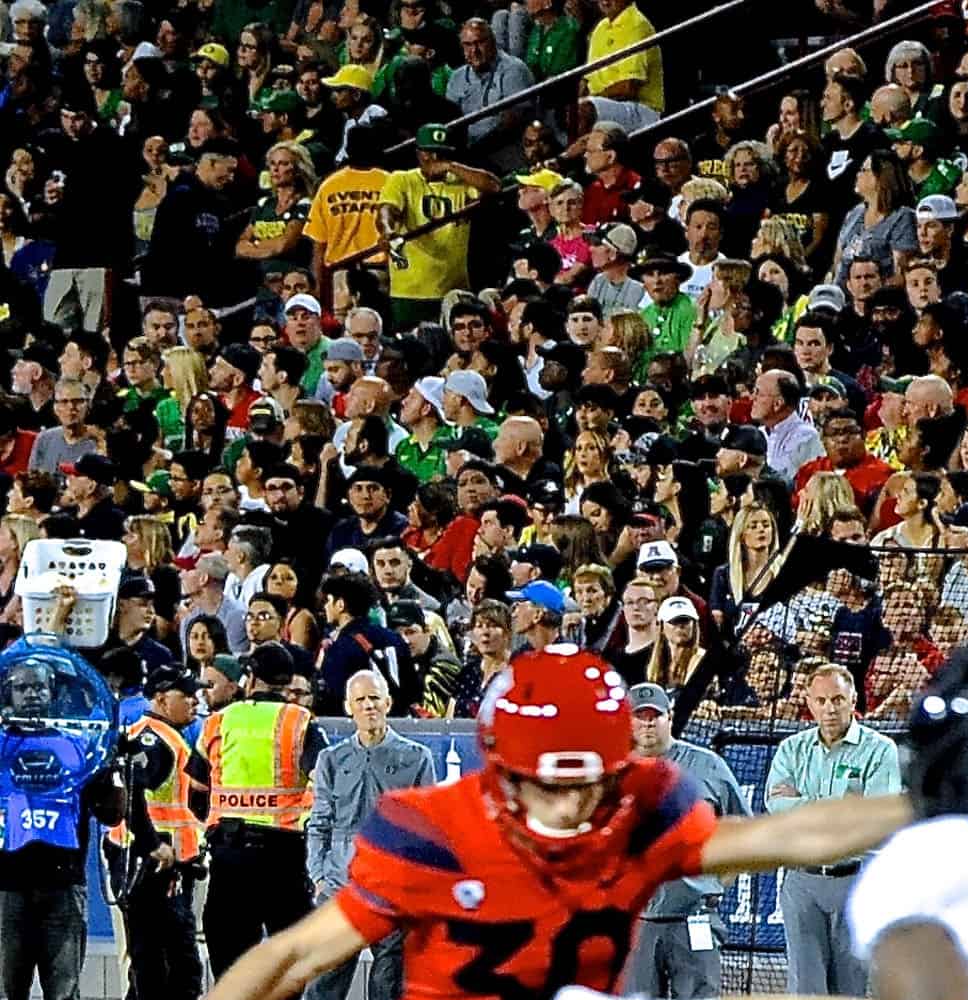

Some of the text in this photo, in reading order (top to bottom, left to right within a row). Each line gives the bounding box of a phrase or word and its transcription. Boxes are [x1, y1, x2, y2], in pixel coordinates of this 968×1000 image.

[327, 190, 381, 204] EVENT
[219, 793, 278, 808] POLICE
[20, 809, 60, 830] 357
